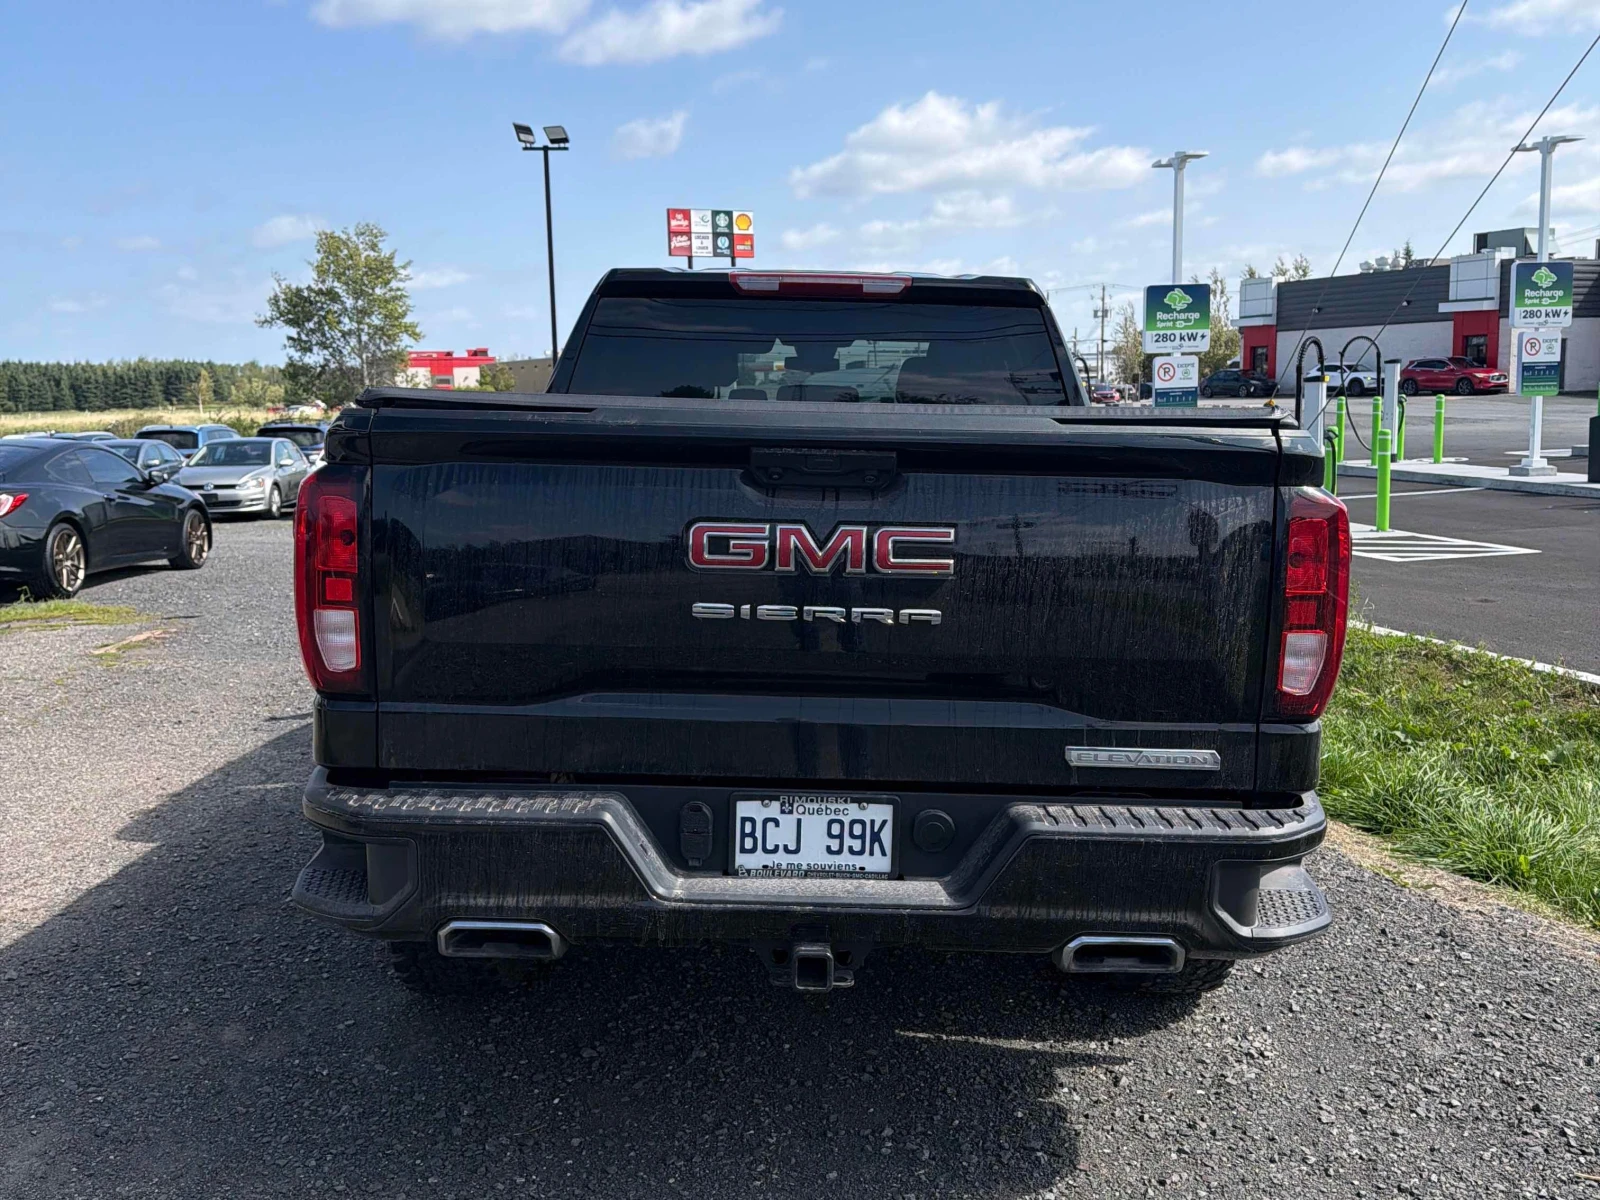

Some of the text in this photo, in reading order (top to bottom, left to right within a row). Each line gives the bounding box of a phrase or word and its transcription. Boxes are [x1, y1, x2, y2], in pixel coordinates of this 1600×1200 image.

[1525, 289, 1564, 298] Recharge
[1156, 311, 1200, 320] Recharge
[1522, 308, 1562, 319] 280 kW
[1156, 320, 1174, 328] Sprint
[1154, 331, 1199, 343] 280 kW
[688, 522, 956, 574] GMC
[691, 602, 942, 625] SIERRA
[1077, 752, 1208, 765] ELEVATION
[779, 795, 850, 805] RIMOUSKI
[796, 804, 850, 816] Québec
[739, 816, 889, 857] BCJ 99K
[770, 860, 857, 871] Je me souviens
[750, 869, 805, 878] BOULEVARD
